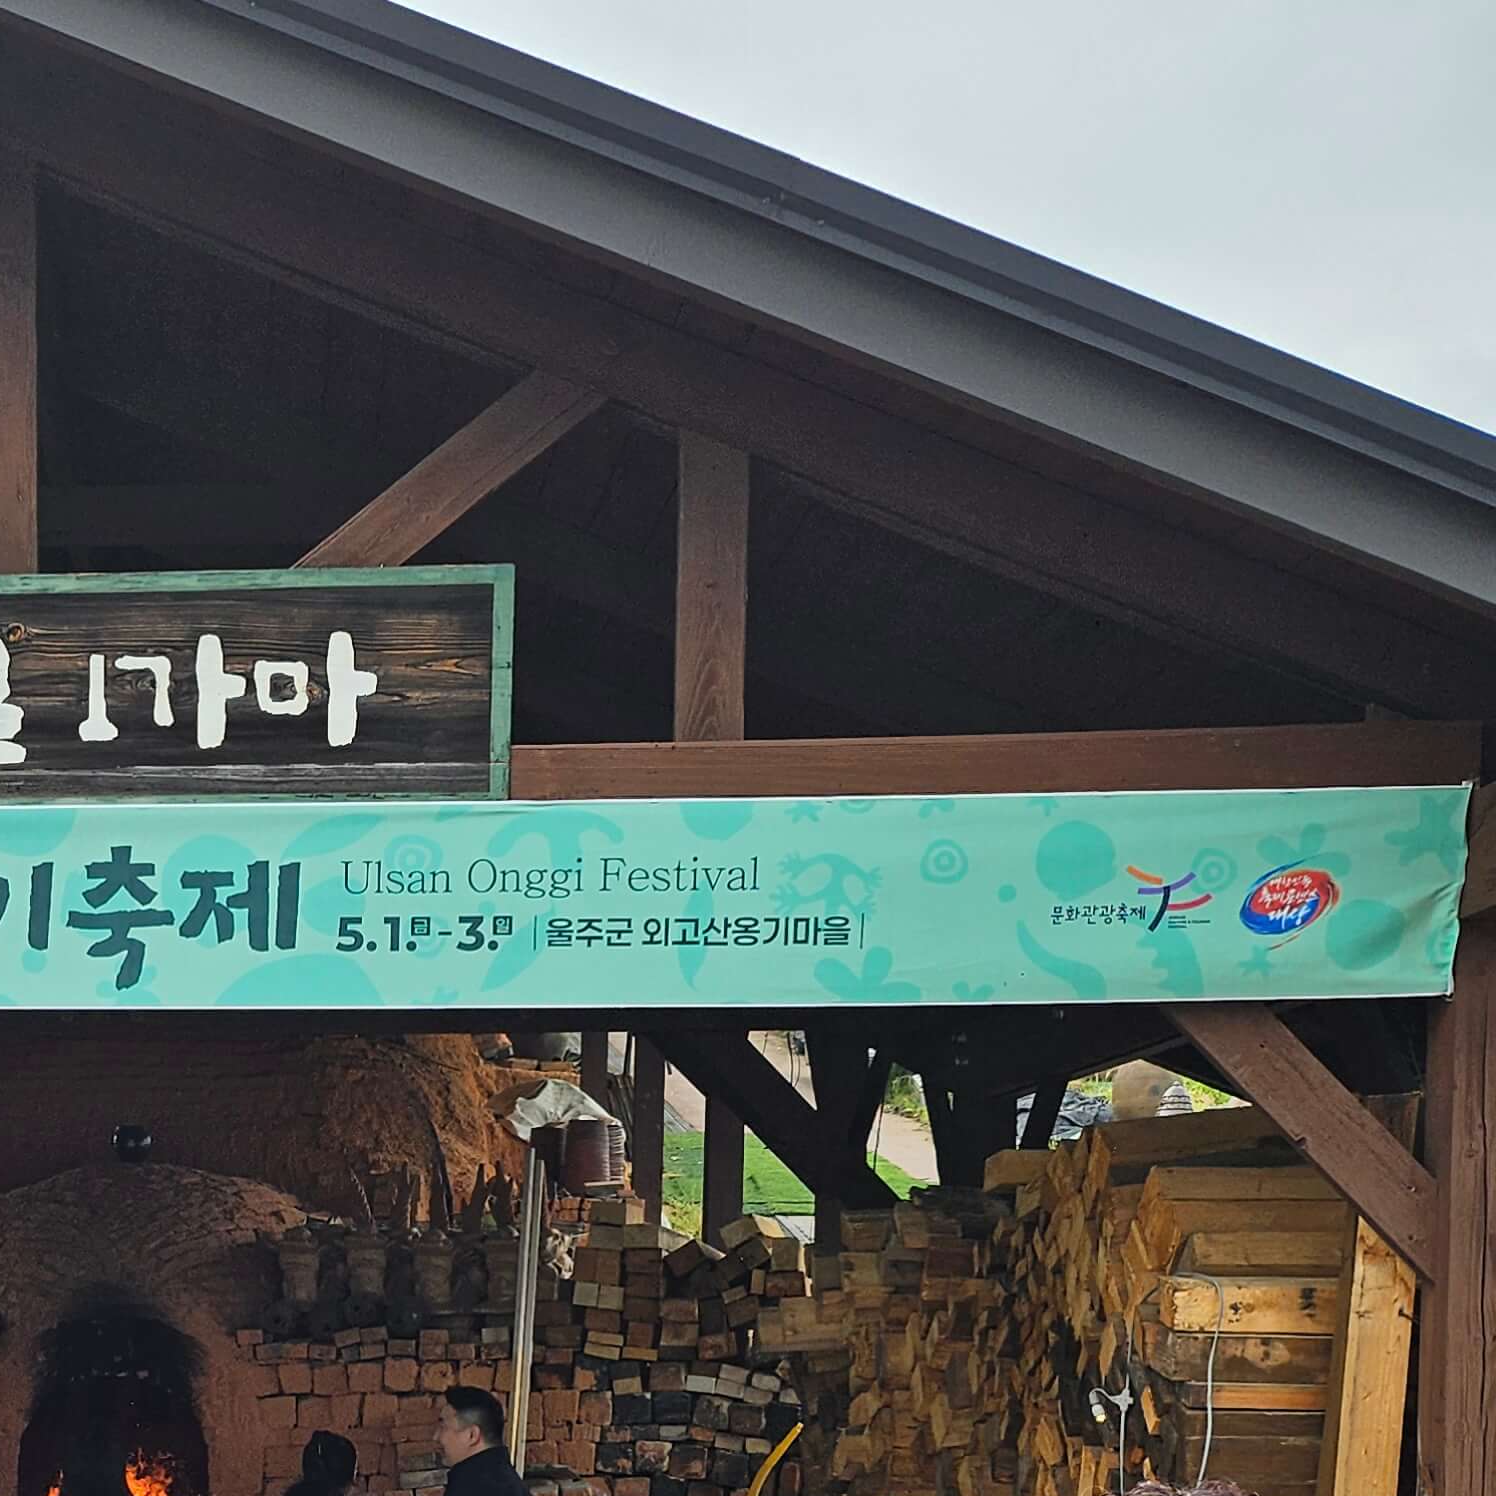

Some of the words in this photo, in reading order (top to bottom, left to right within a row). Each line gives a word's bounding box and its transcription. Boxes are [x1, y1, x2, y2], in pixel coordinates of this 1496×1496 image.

[340, 860, 453, 895] Ulsan
[467, 857, 584, 899] Onggi
[599, 855, 760, 892] Festival
[1050, 902, 1147, 926] 문화관광축제
[545, 917, 634, 948] 울주군
[641, 916, 851, 947] 외고산옹기마을
